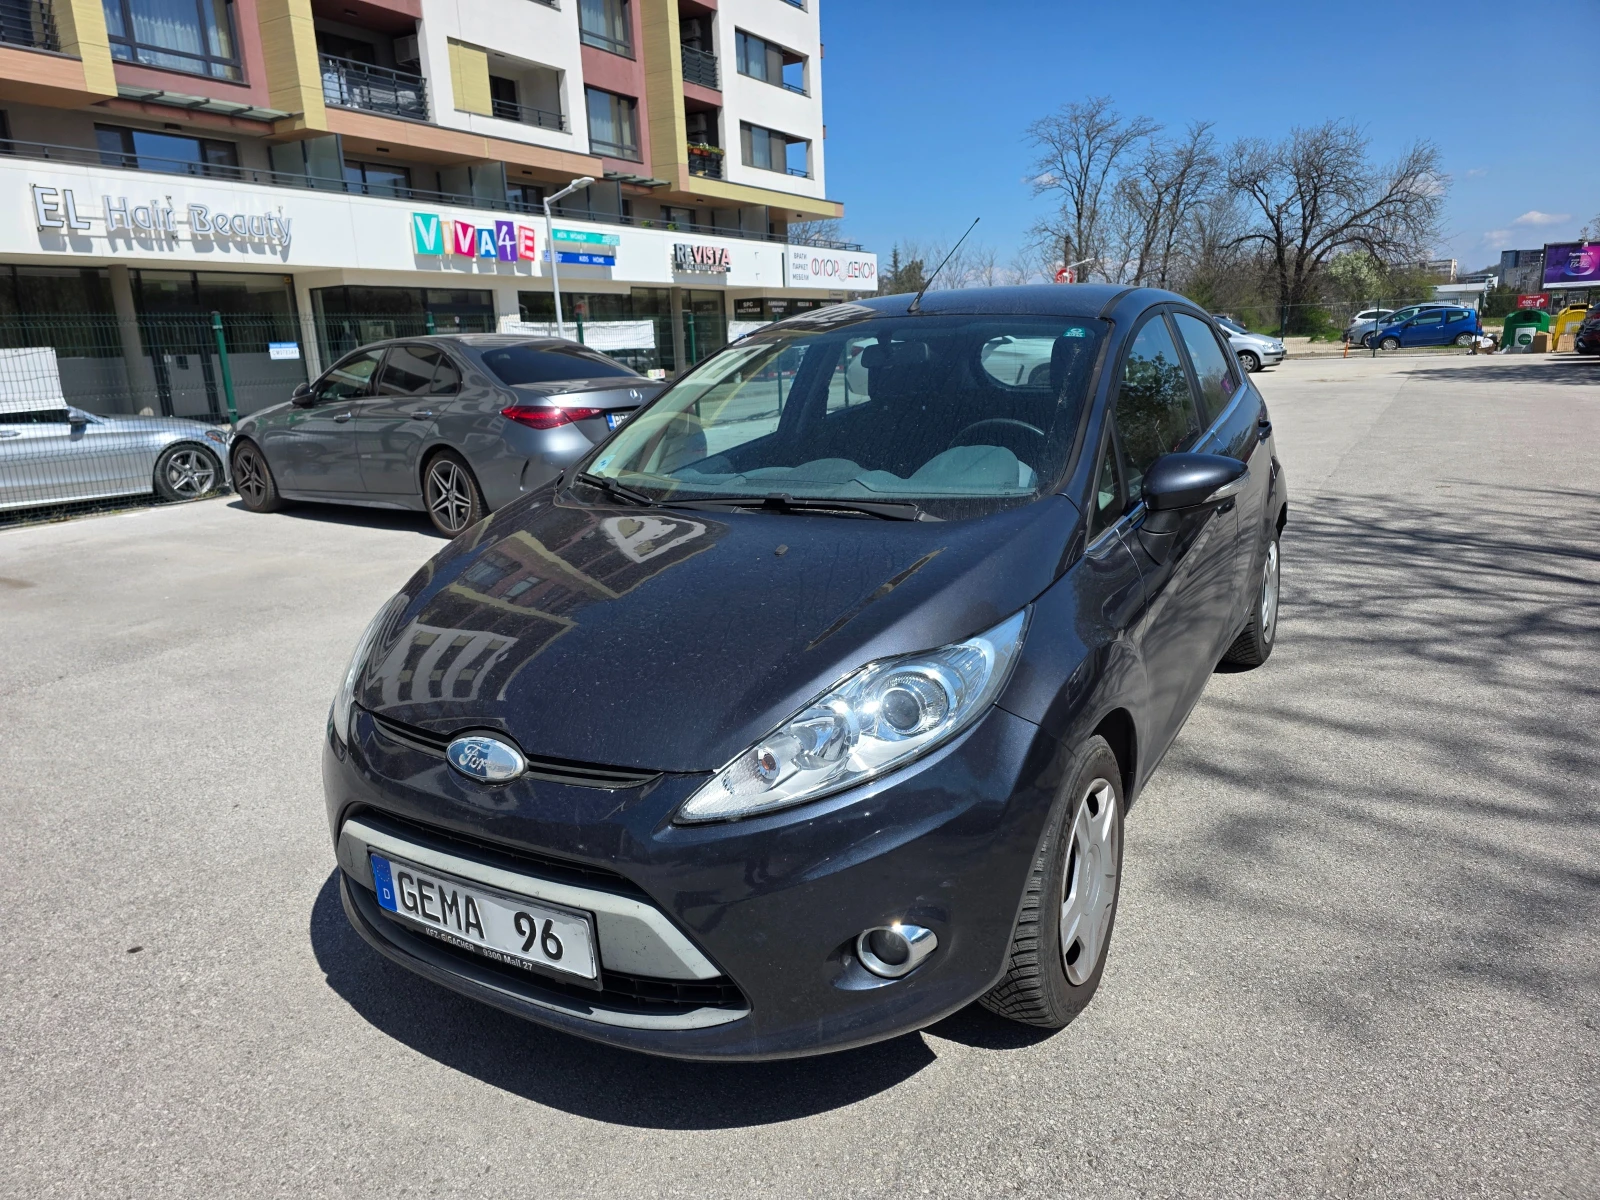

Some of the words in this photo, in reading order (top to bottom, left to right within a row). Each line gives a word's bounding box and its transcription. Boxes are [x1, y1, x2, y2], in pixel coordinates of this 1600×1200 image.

[32, 186, 91, 230] EL
[102, 194, 174, 232] Hair
[188, 202, 293, 246] Beauty
[674, 243, 732, 266] REVISTA
[848, 261, 876, 279] ДЕКОР
[383, 888, 391, 900] D
[397, 871, 486, 940] GEMA
[514, 911, 564, 961] 96
[483, 948, 502, 961] 9300
[523, 962, 533, 971] 27
